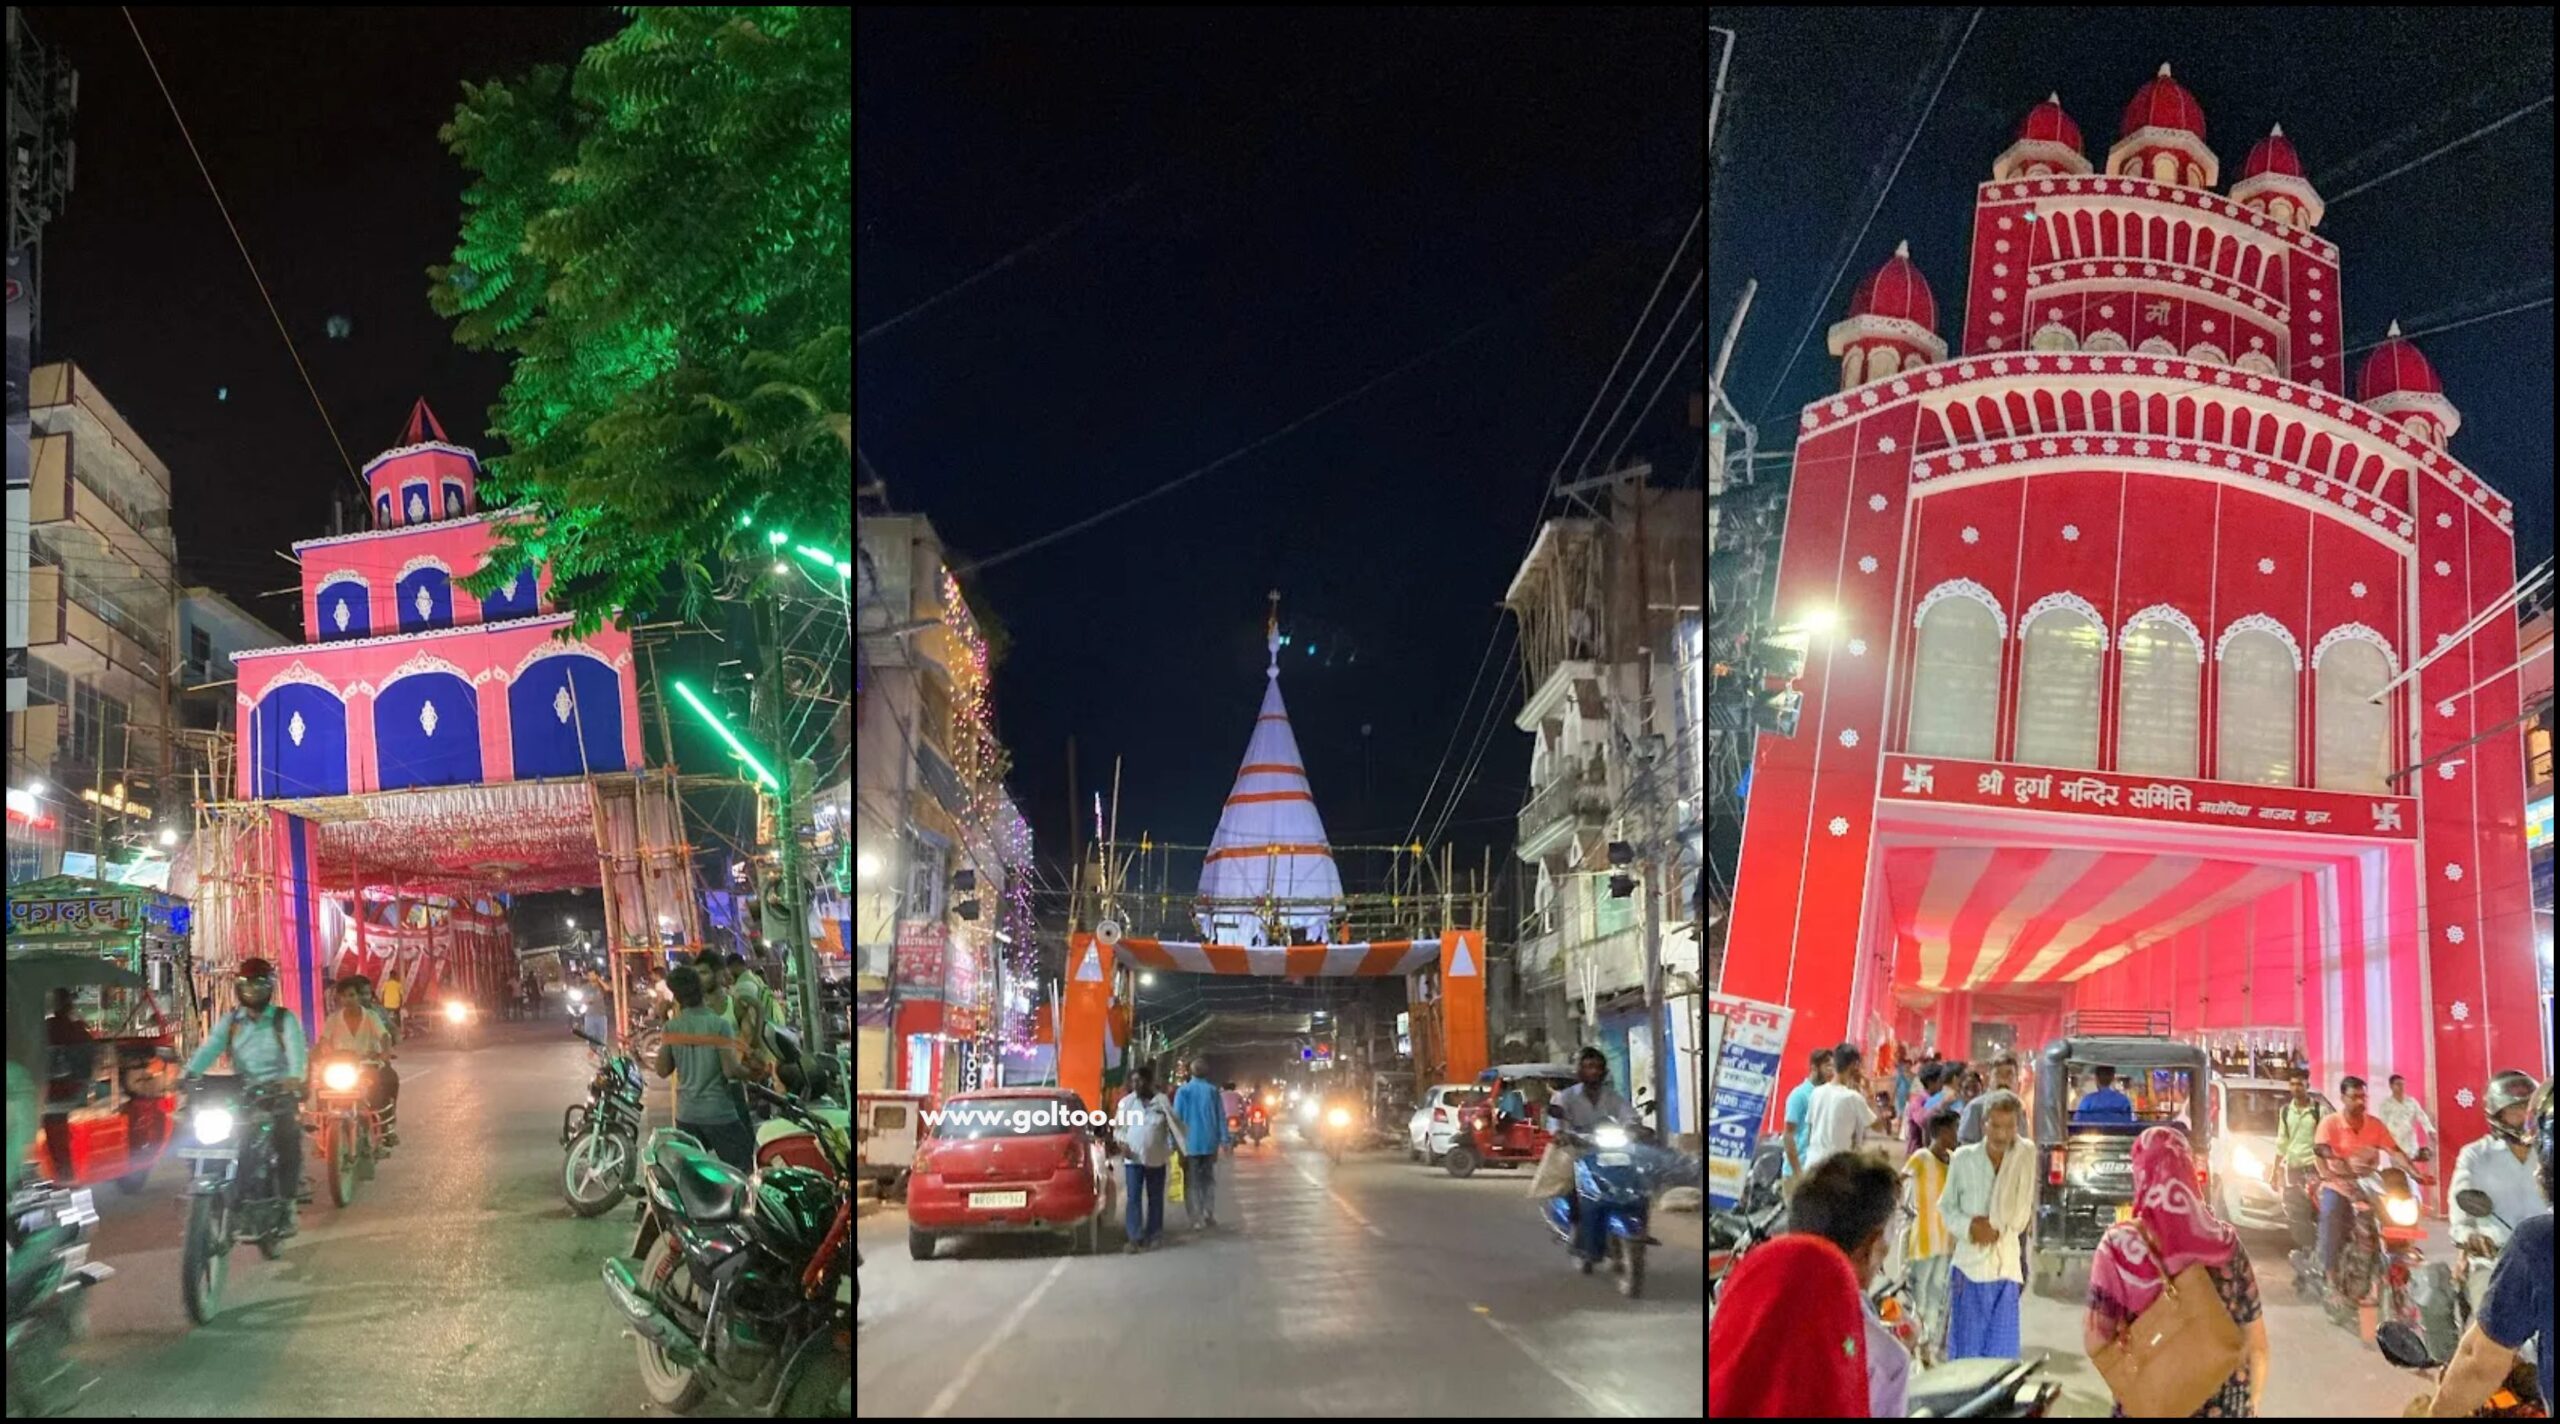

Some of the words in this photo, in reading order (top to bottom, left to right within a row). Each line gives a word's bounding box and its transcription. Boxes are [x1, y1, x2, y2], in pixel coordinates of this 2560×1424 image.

[1977, 769, 2005, 796] श्री
[2013, 774, 2053, 804] दुर्गा
[2060, 777, 2120, 807] मन्दिर
[2128, 783, 2194, 812] समिति
